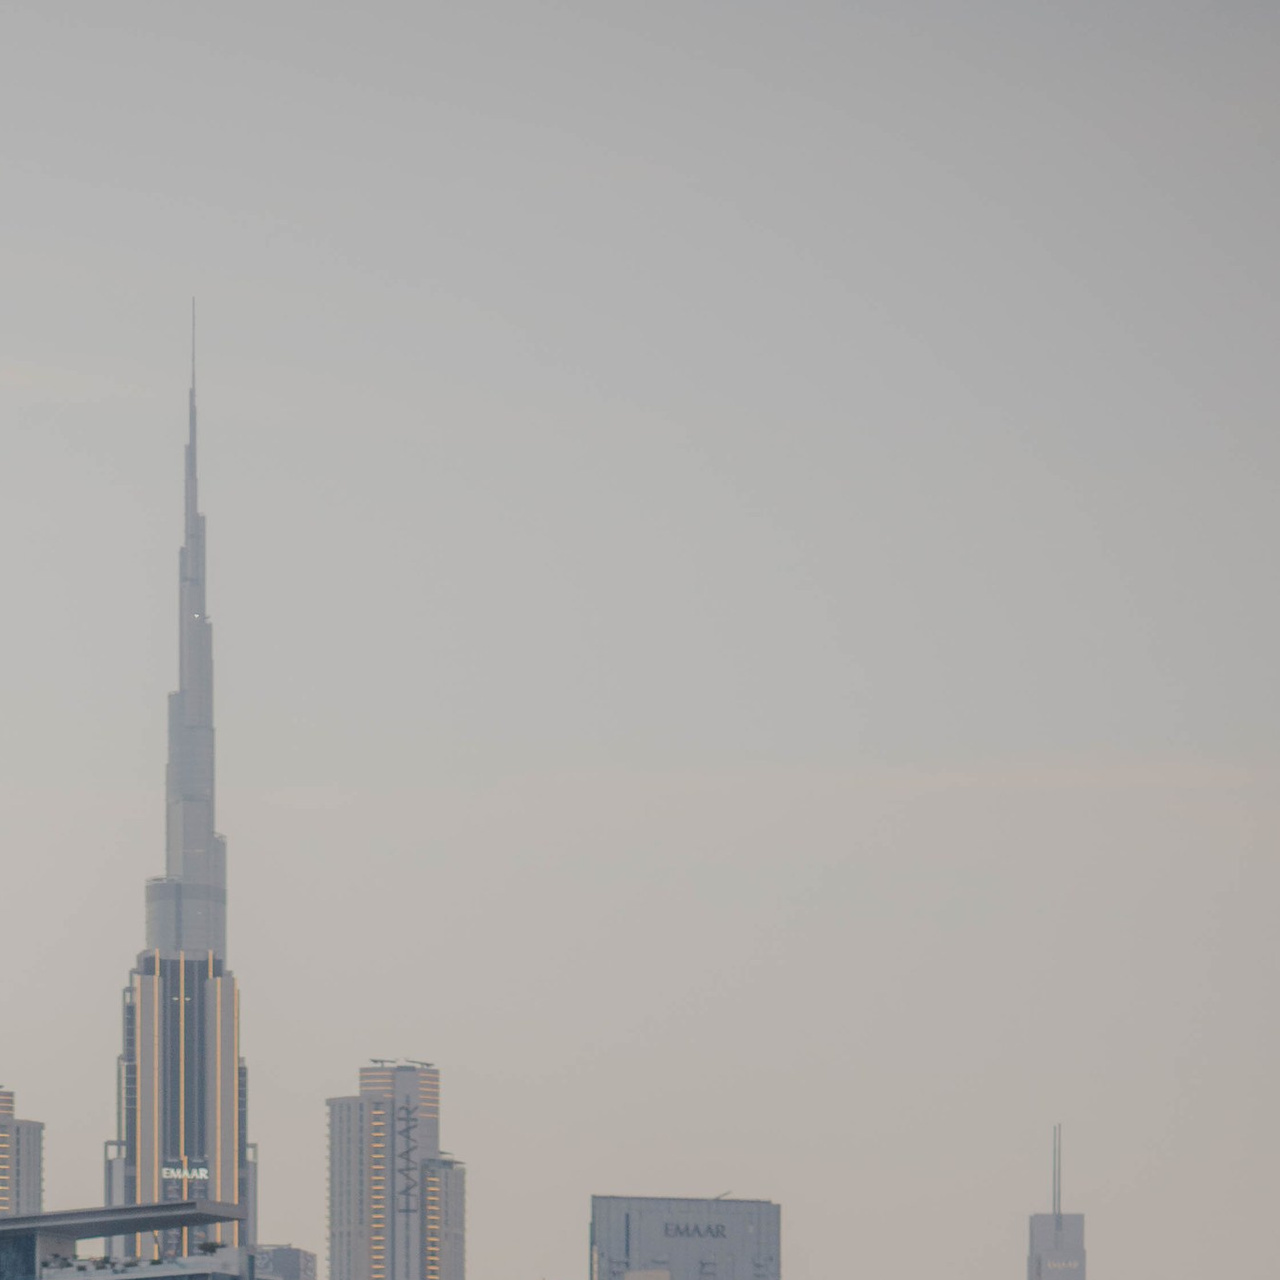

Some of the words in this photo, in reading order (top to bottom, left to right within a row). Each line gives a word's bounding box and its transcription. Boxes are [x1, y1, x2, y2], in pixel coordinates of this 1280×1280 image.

[396, 1104, 419, 1213] EMAAR
[161, 1167, 209, 1180] EMAAR
[663, 1222, 728, 1240] EMAAR
